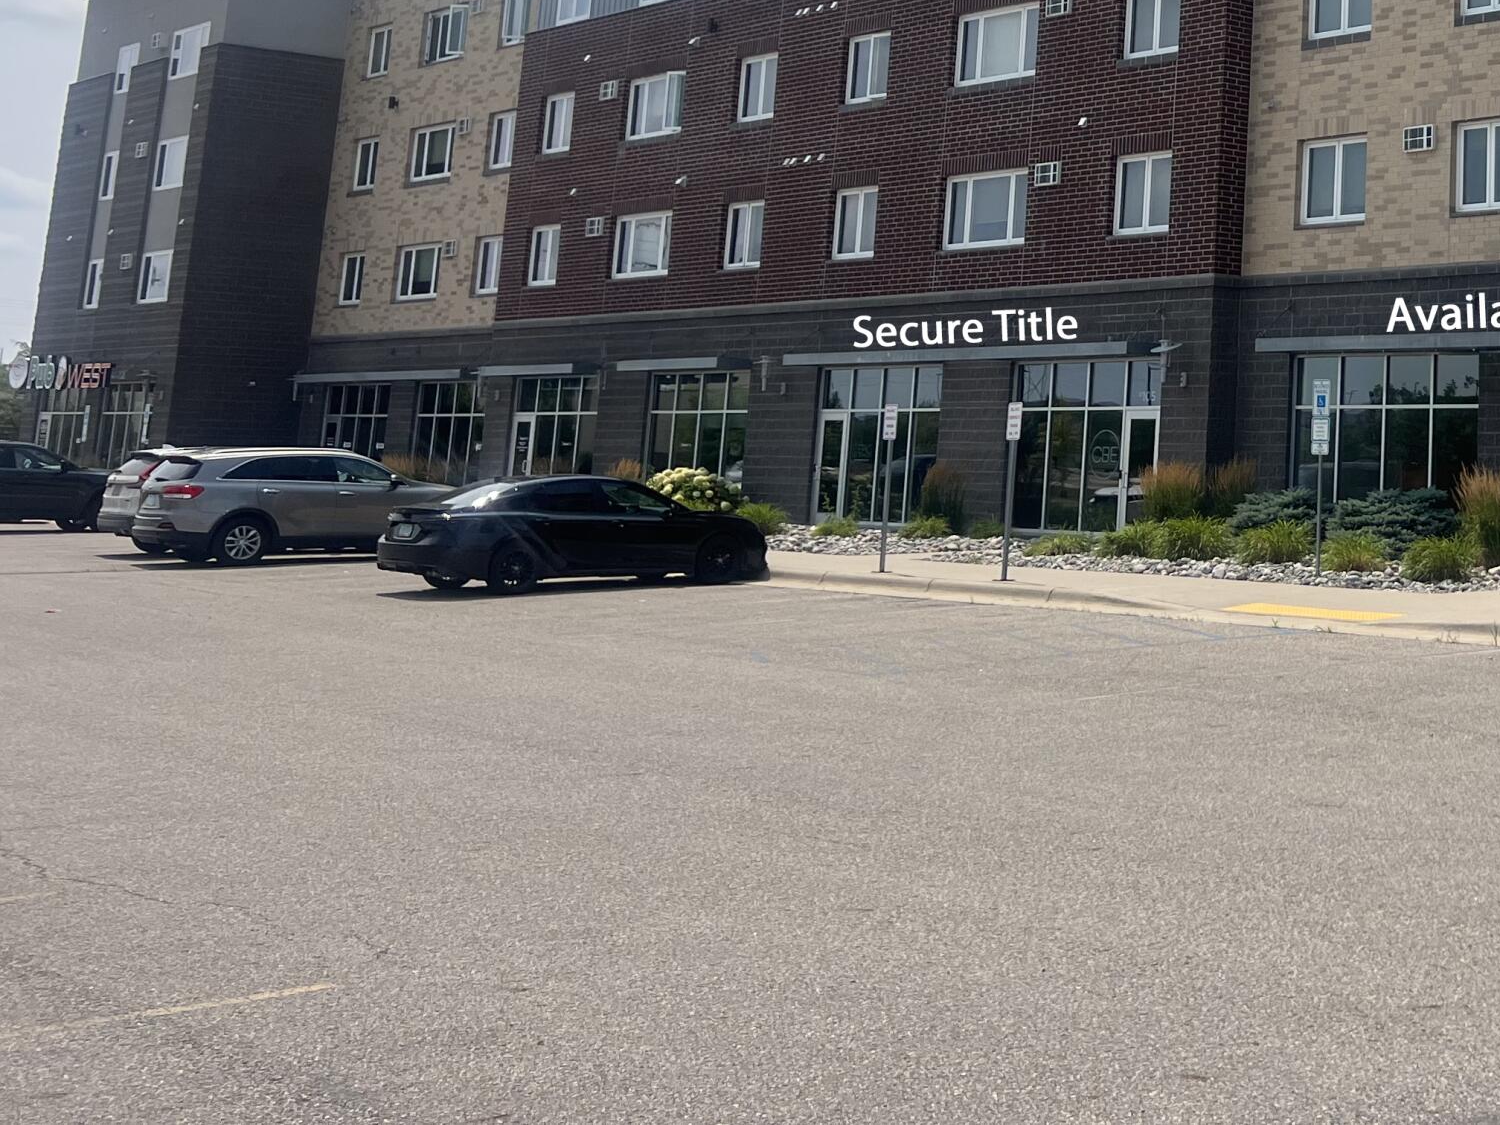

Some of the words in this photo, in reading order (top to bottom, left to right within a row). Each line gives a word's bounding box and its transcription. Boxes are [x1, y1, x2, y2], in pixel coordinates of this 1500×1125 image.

[26, 355, 56, 390] Pub
[67, 362, 112, 389] WEST
[1092, 446, 1119, 463] CBE
